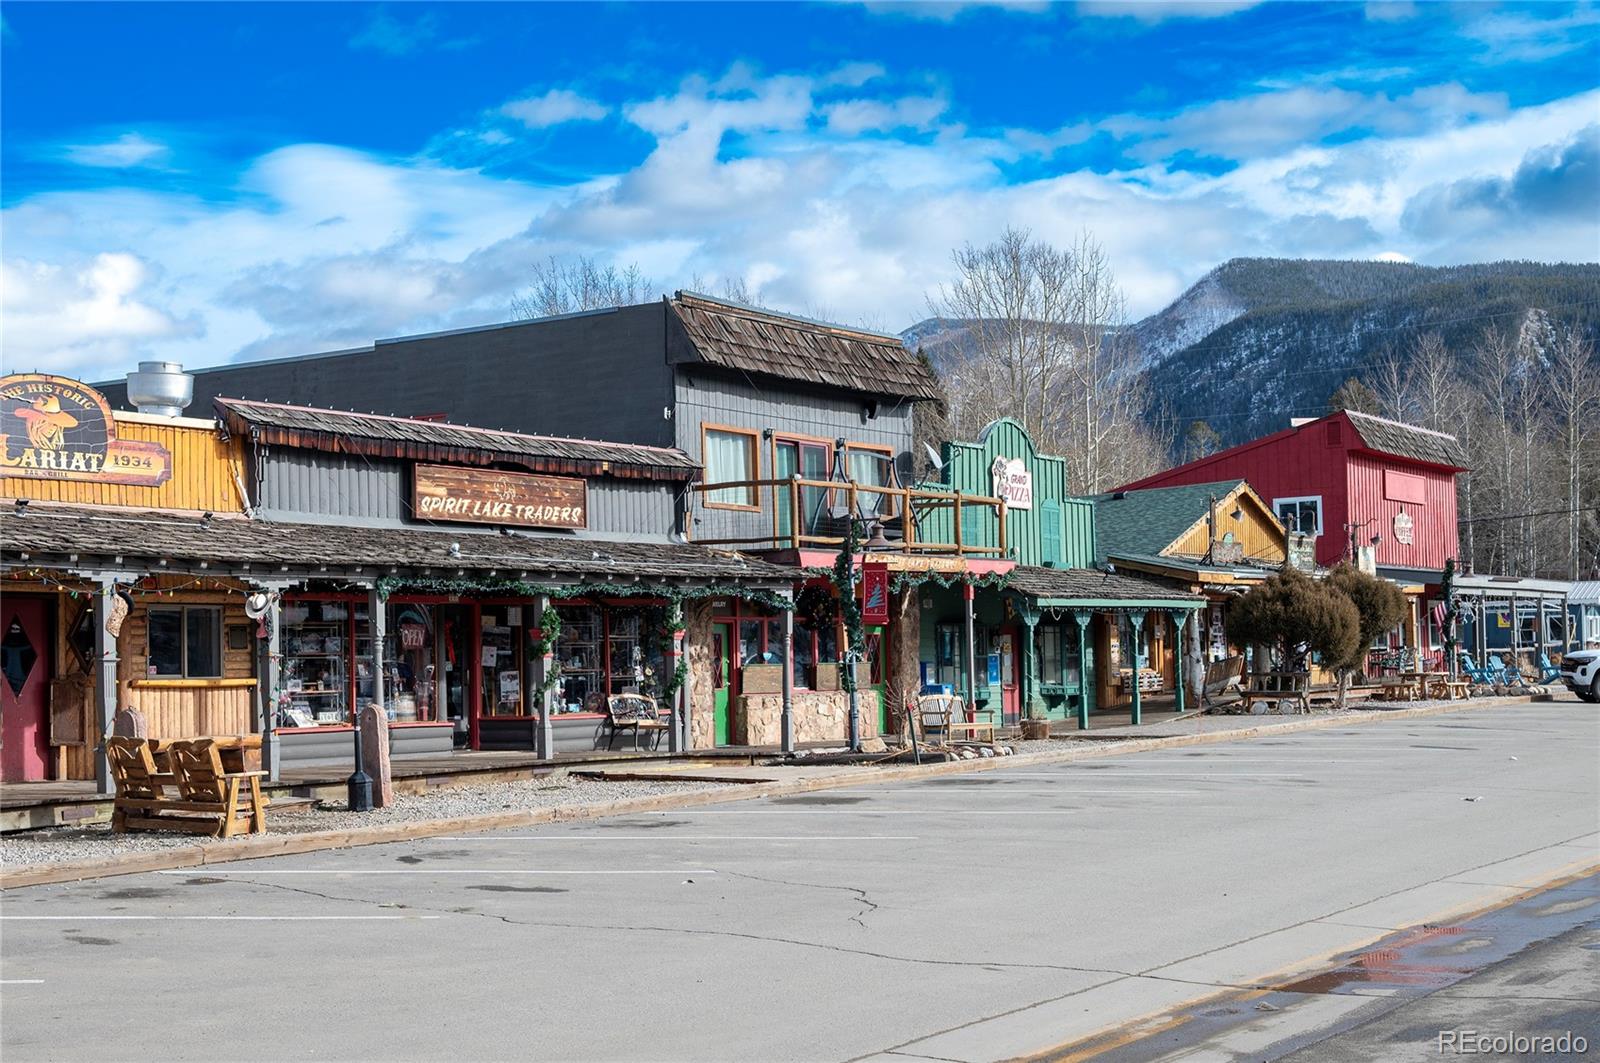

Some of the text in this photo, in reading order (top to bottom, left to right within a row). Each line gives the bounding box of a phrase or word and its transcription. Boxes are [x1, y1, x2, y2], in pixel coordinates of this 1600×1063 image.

[26, 383, 95, 410] HISTORIC
[0, 433, 103, 472] LARIAT
[112, 454, 152, 468] 1934
[1004, 484, 1030, 502] PIZZA
[421, 496, 582, 522] SPIRIT LAKE TRADERS
[402, 629, 425, 646] OPEN
